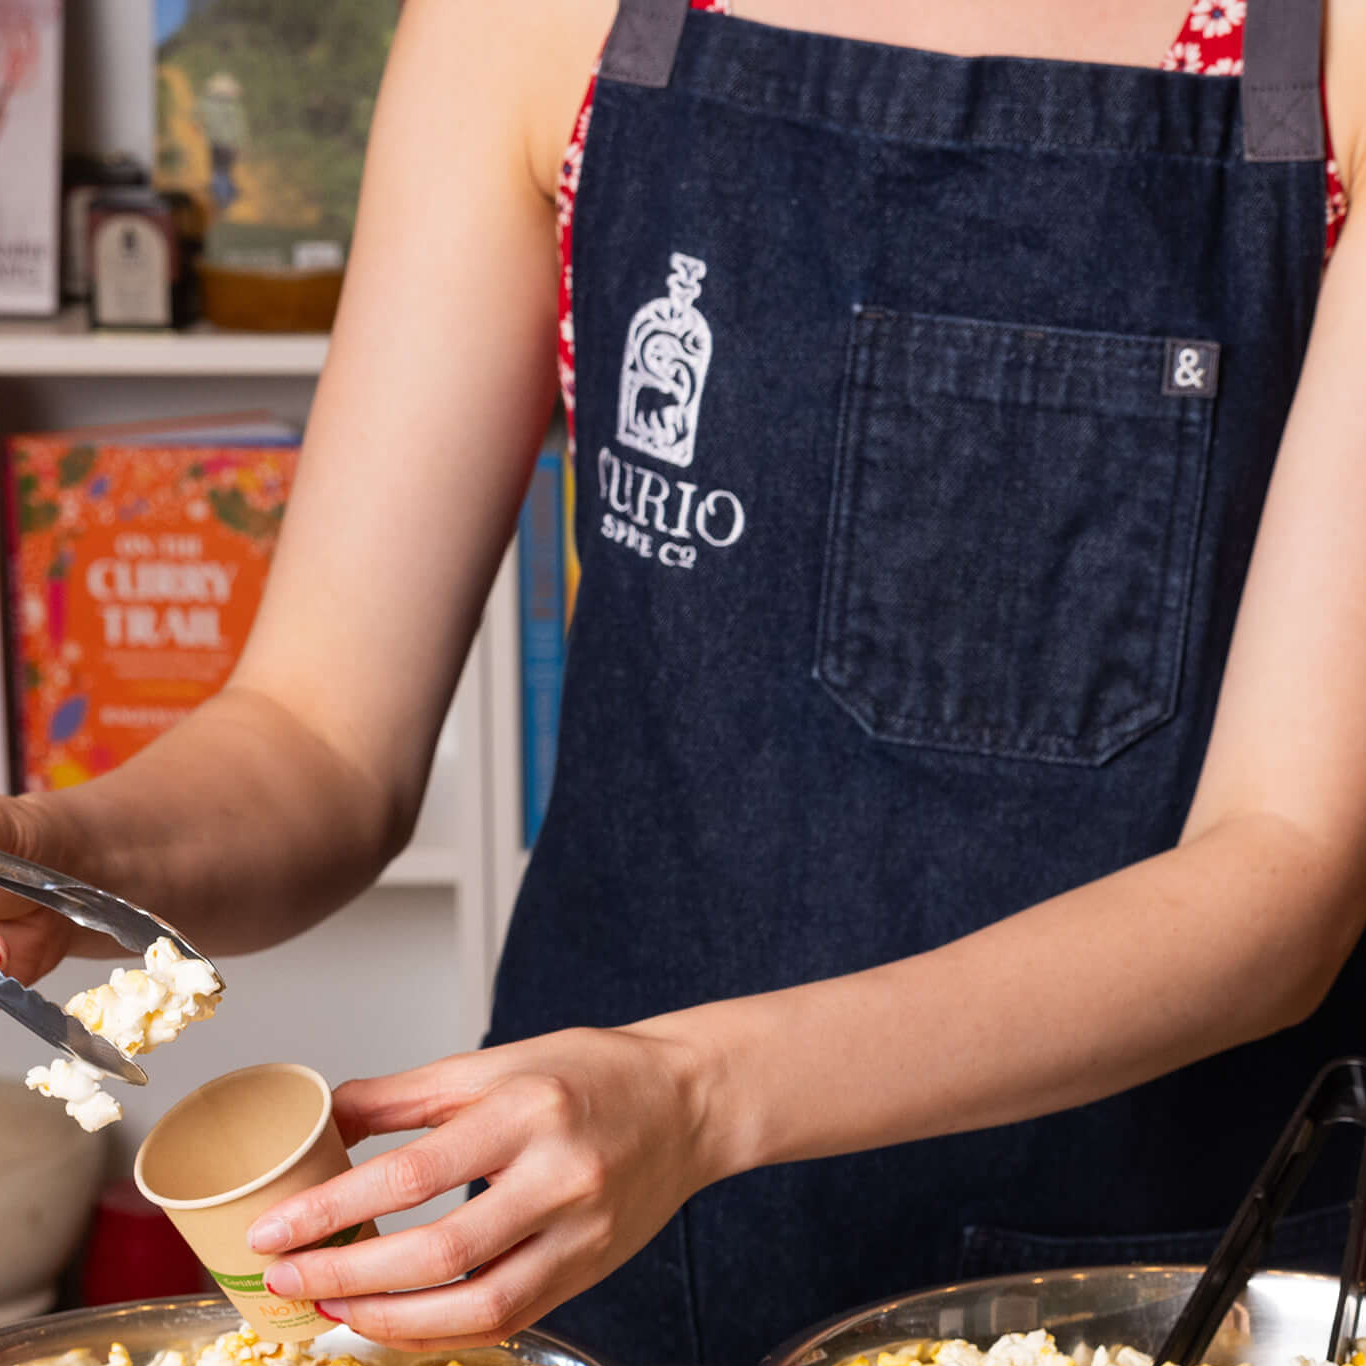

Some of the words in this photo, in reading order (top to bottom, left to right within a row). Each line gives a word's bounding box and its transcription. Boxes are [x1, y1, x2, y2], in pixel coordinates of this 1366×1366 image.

[1175, 348, 1206, 388] &
[87, 558, 238, 603] CURRY
[101, 604, 224, 647] TRAIL
[223, 1278, 263, 1287] Certifie
